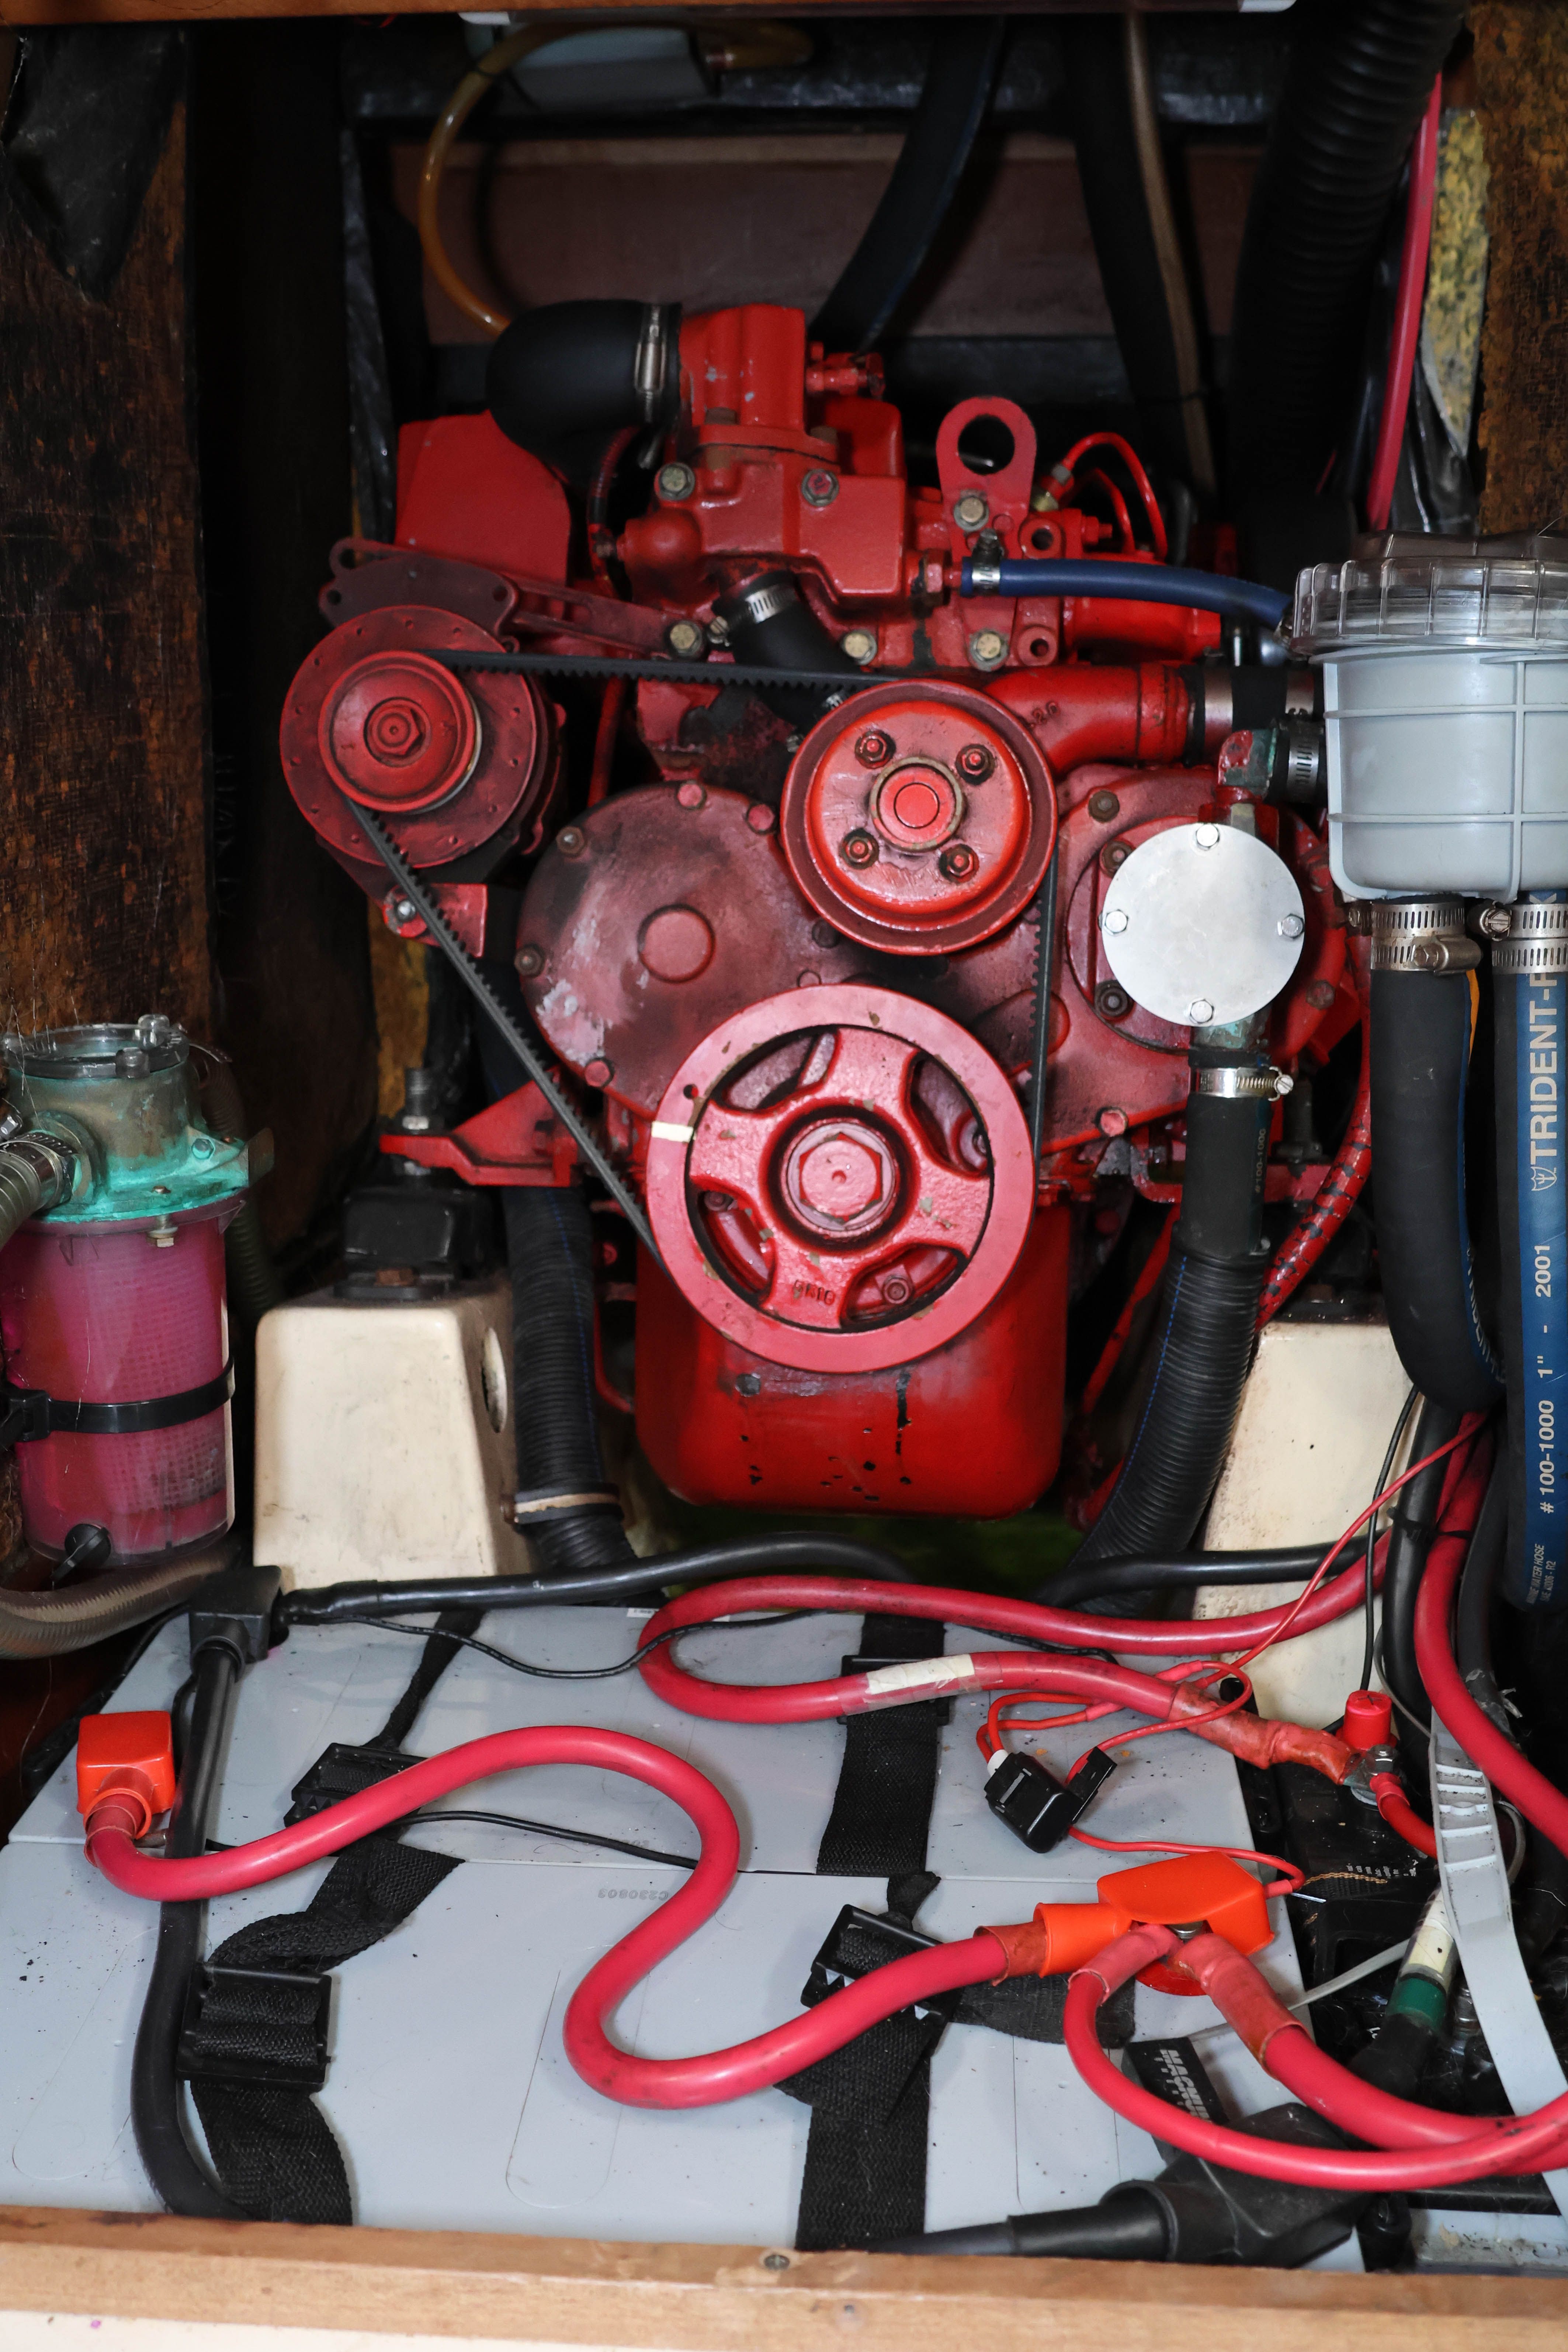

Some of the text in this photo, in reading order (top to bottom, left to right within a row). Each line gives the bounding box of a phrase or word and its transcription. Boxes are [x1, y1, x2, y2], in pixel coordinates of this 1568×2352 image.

[1534, 1244, 1551, 1298] 2001
[1537, 1356, 1553, 1378] 1"
[1538, 1400, 1554, 1495] 100-1000
[1534, 1543, 1544, 1566] HOSE
[1546, 1561, 1556, 1570] R2
[1531, 1566, 1542, 1587] WATER
[1160, 2049, 1212, 2121] MAGNU
